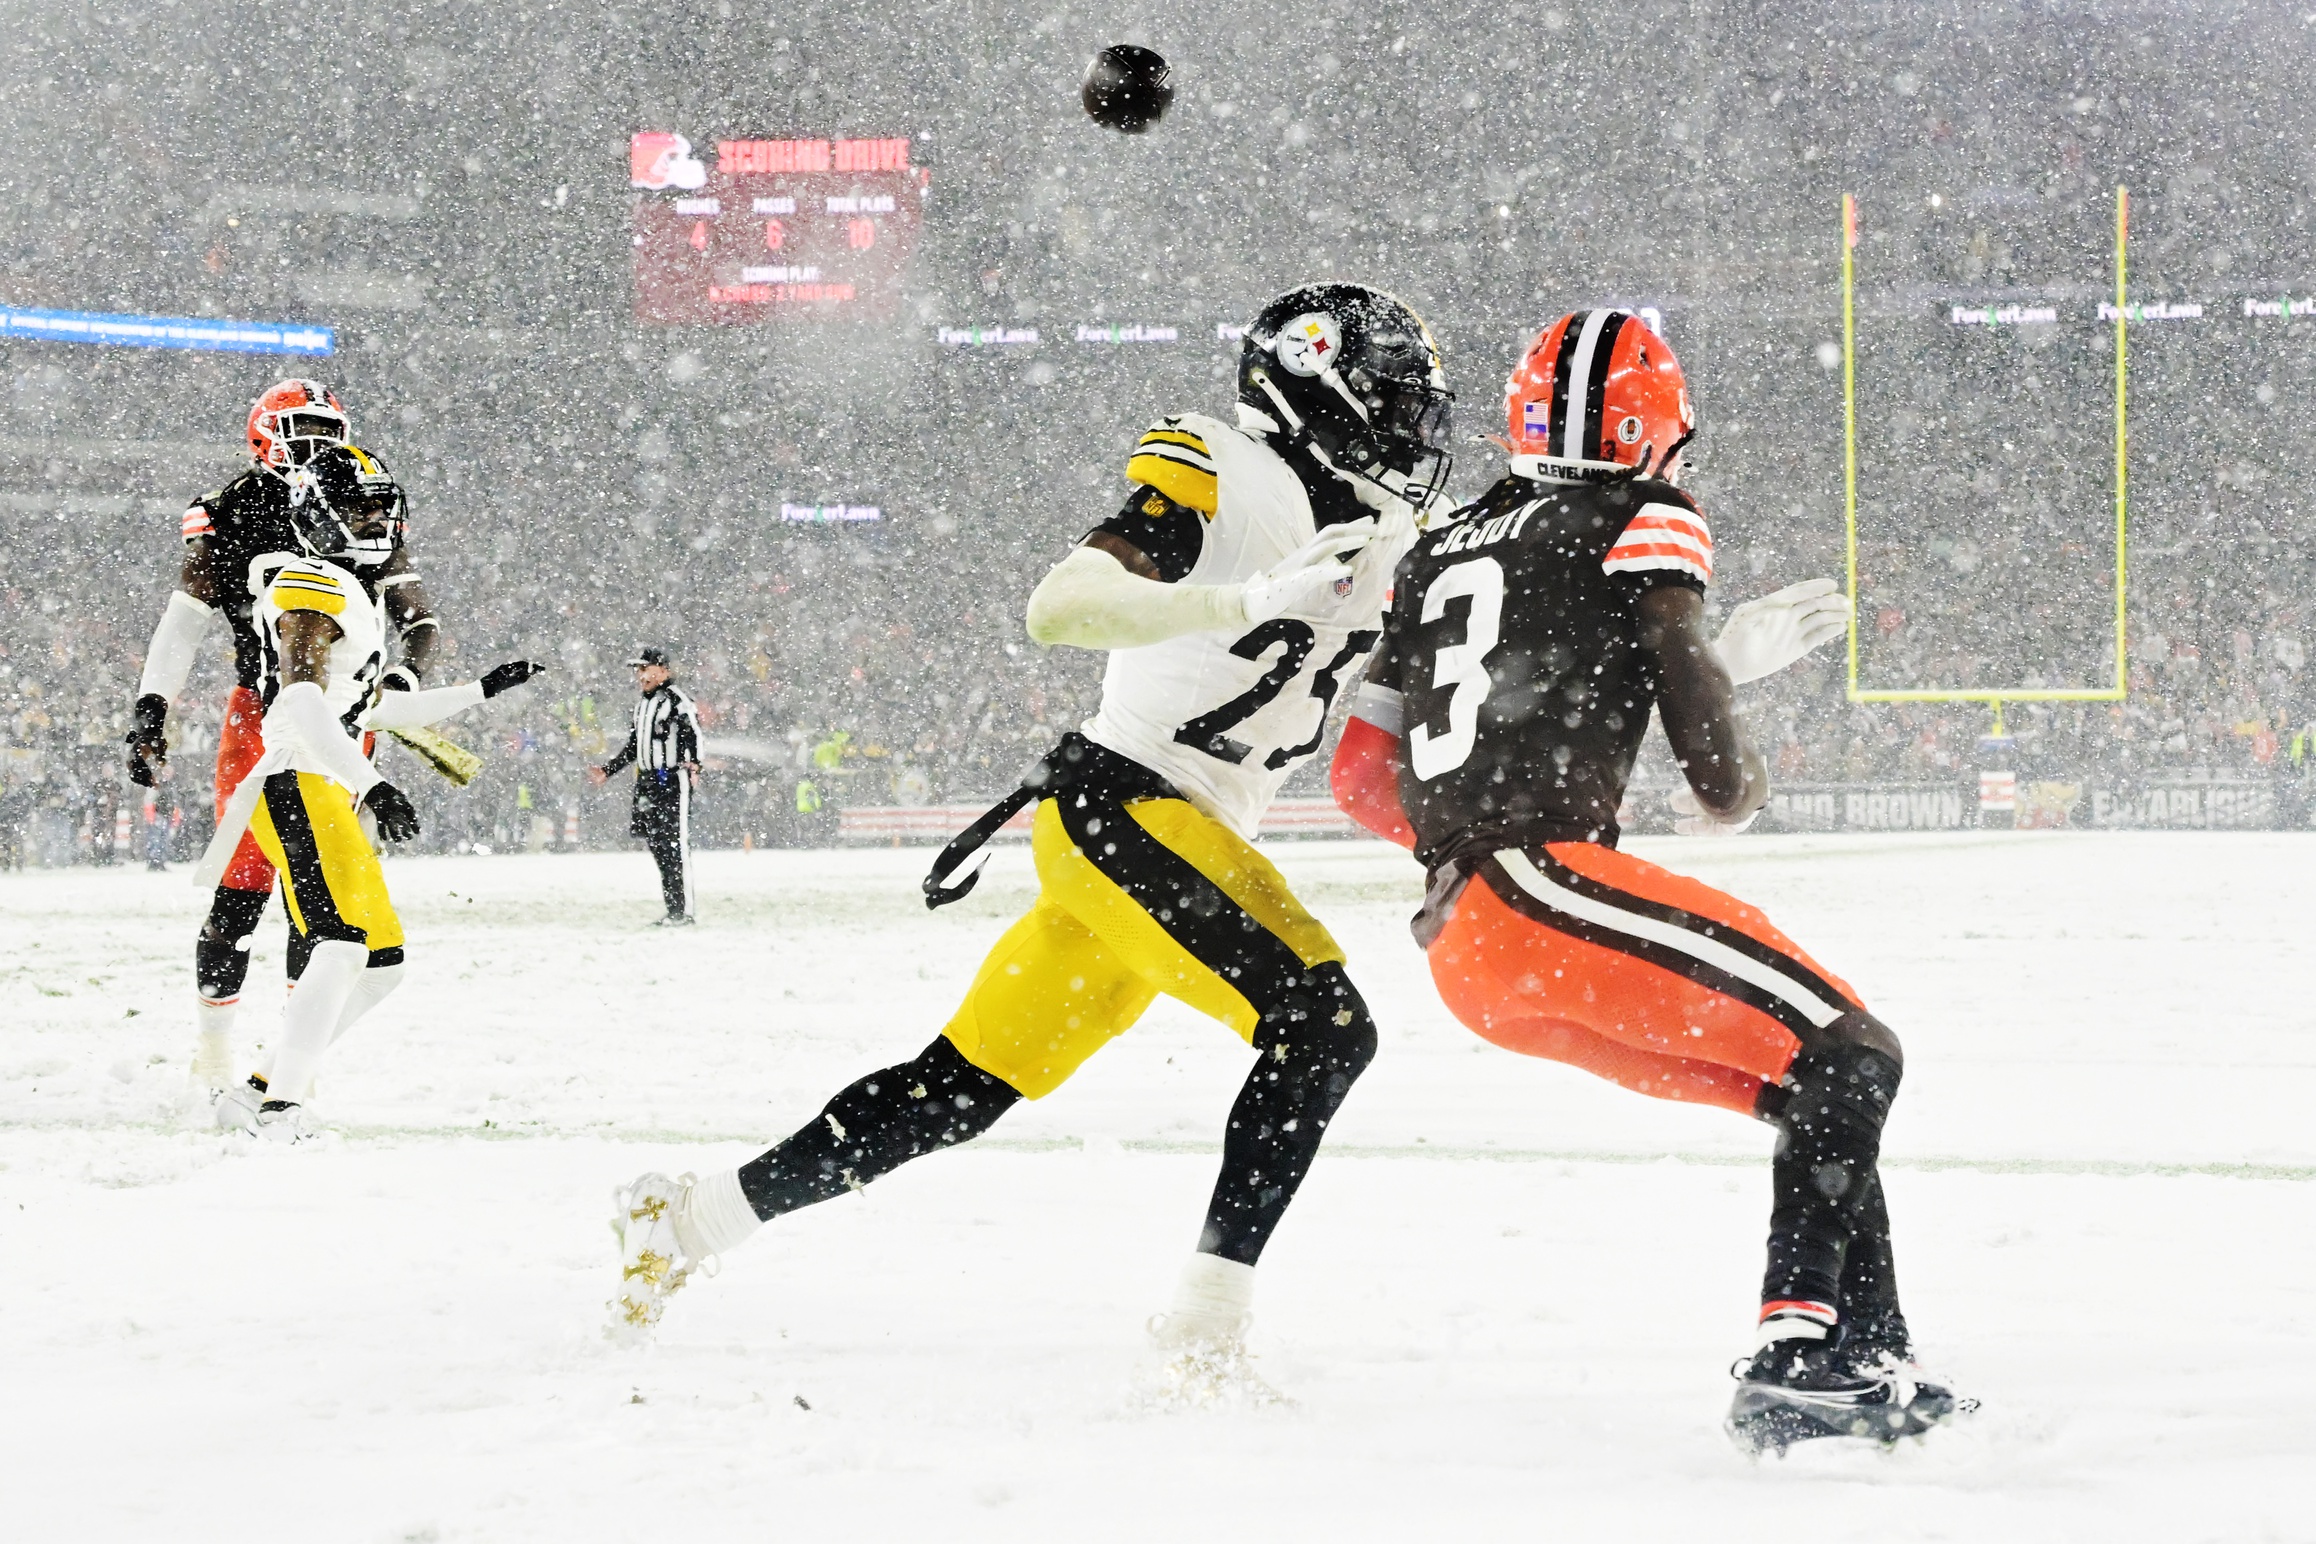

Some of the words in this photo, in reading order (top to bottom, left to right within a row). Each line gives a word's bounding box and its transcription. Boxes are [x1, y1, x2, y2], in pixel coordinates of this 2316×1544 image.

[718, 140, 830, 172] SCORING
[834, 138, 910, 171] DRIVE
[753, 197, 796, 213] PASSES
[826, 197, 858, 212] TOTAL
[860, 195, 895, 212] PLAYS
[690, 220, 708, 250] 4
[767, 219, 783, 249] 6
[742, 266, 788, 282] SCORING
[1430, 497, 1552, 557] JEUDY
[1409, 556, 1505, 782] 3
